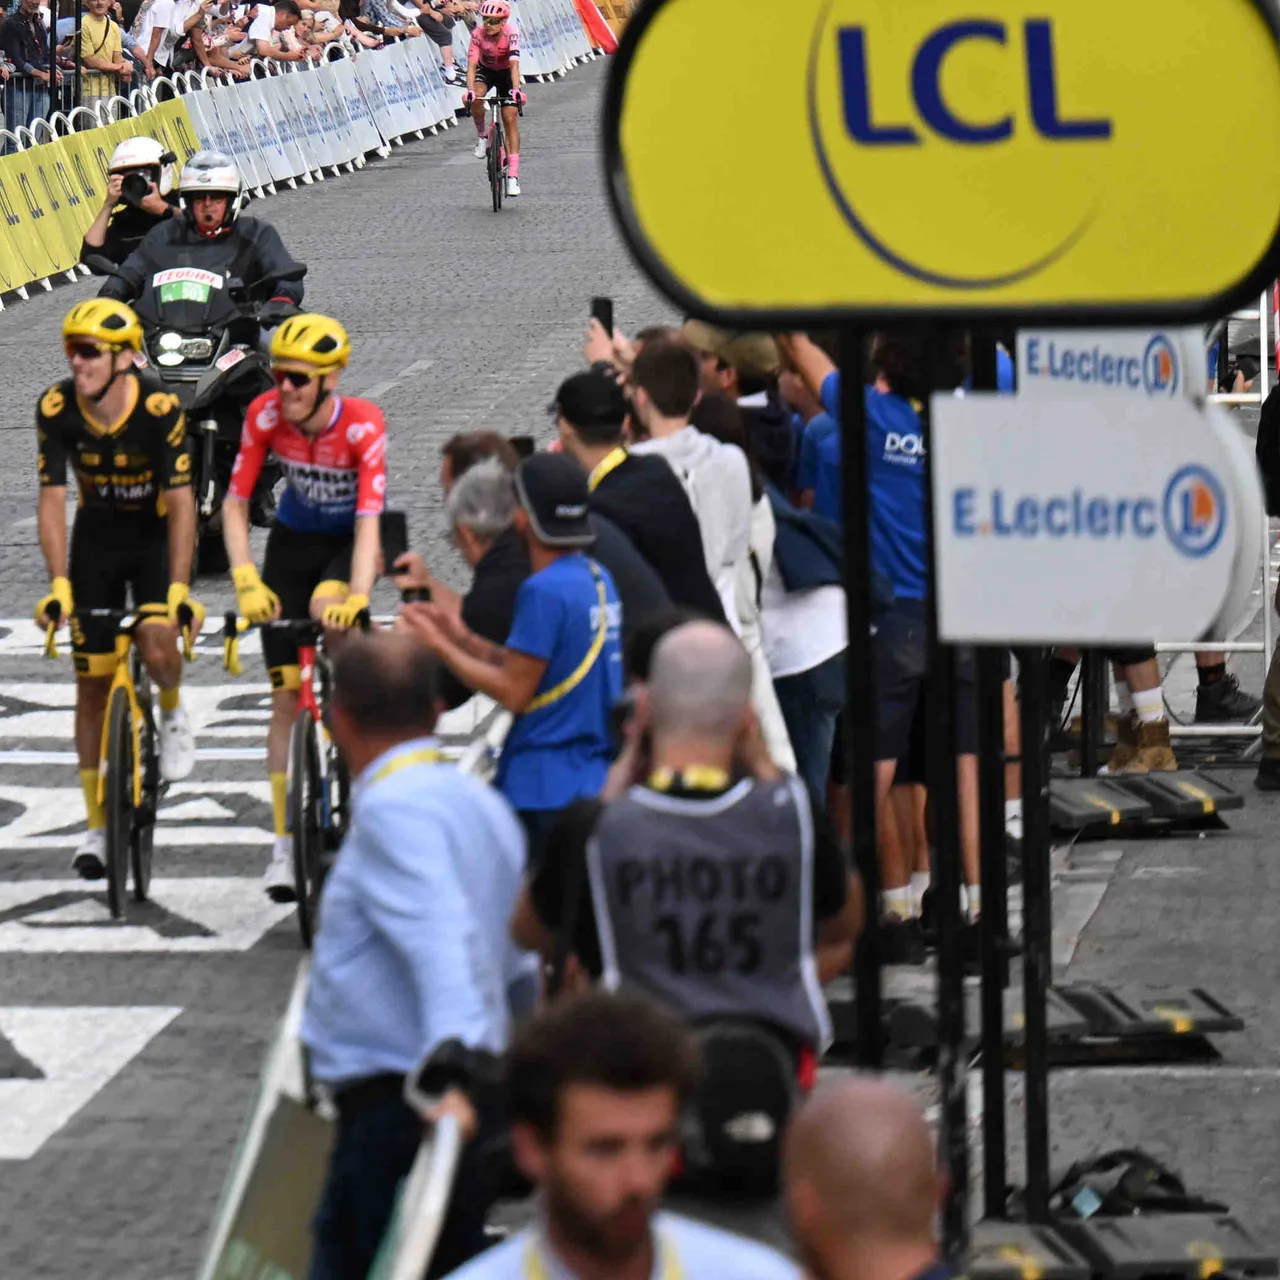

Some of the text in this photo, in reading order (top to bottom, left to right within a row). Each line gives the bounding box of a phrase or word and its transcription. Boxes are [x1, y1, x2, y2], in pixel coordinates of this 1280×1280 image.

[836, 17, 1113, 147] LCL
[16, 172, 45, 219] LCL
[1026, 336, 1140, 388] E.Leclerc
[952, 489, 1157, 542] E.Leclerc
[616, 856, 790, 903] PHOTO
[654, 916, 764, 974] 165
